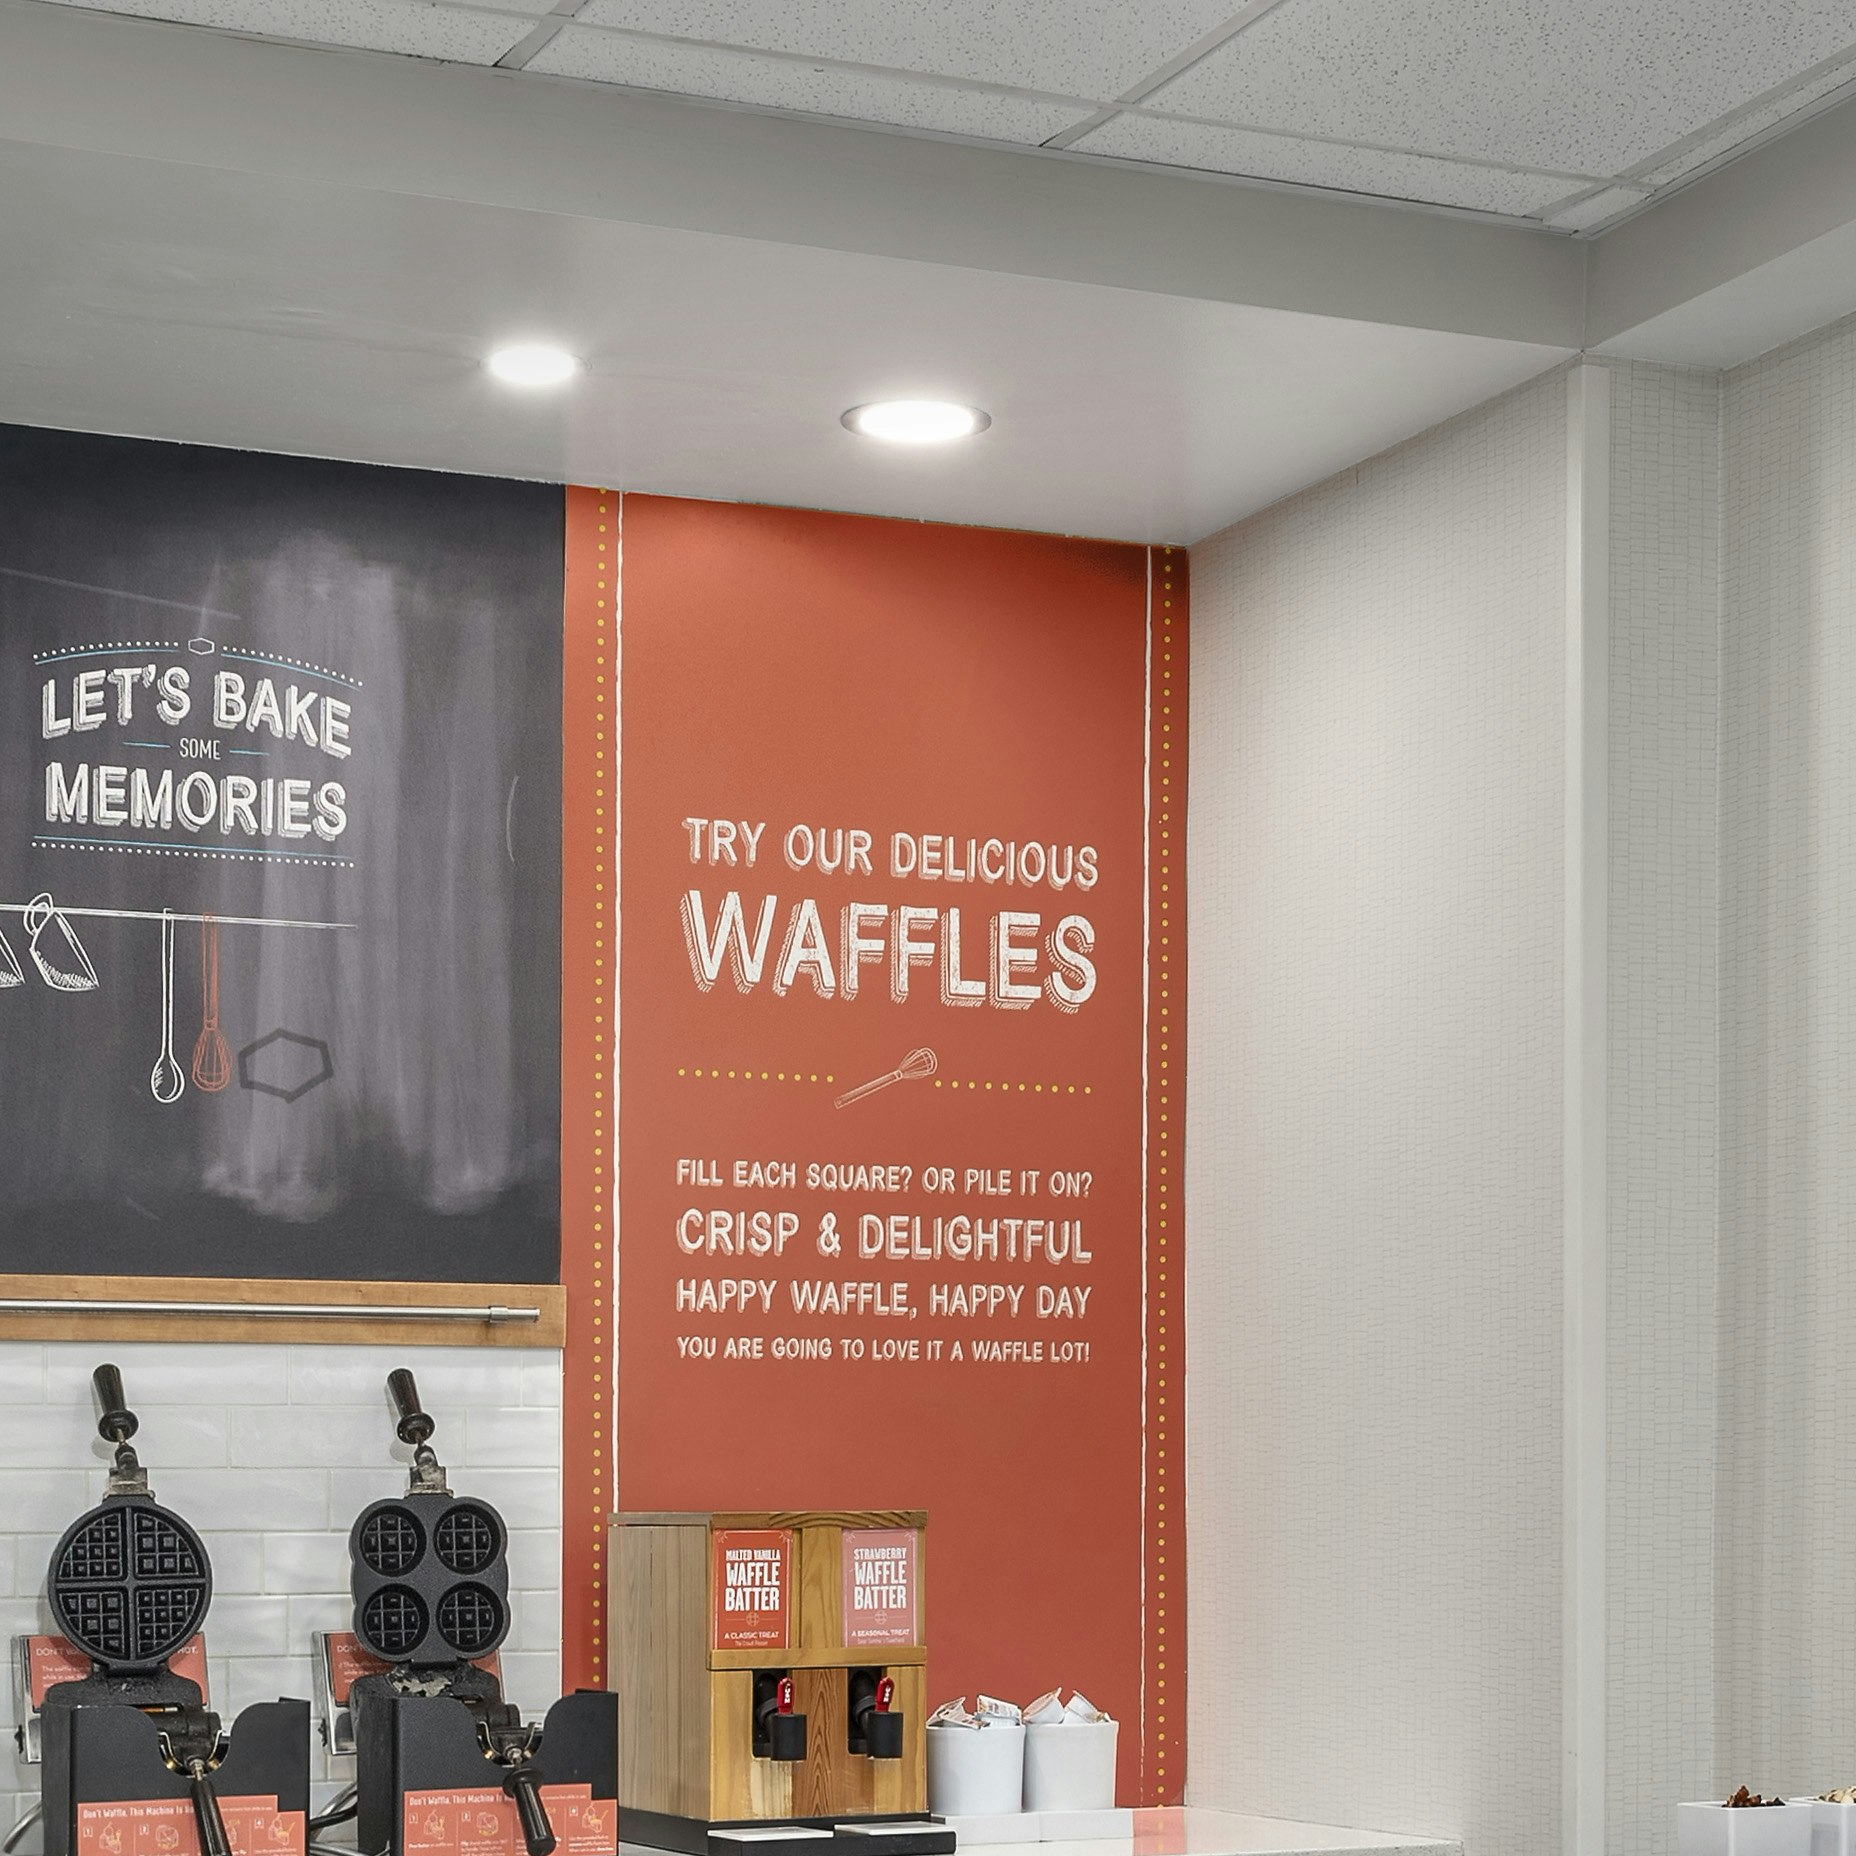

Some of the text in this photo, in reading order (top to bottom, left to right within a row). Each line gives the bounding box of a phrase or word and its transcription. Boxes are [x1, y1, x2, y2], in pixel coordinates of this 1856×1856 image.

[42, 664, 352, 759] LET'S BAKE
[179, 737, 221, 761] SOME
[45, 762, 348, 842] MEMORIES
[681, 817, 1099, 891] TRY OUR DELICIOUS
[680, 889, 1097, 1014] WAFFLES
[676, 1159, 1093, 1198] FILL EACH SQUARE? OR PILE IT ON?
[676, 1208, 1092, 1264] CRISP & DELIGHTFUL
[676, 1278, 1092, 1320] HAPPY WAFFLE, HAPPY DAY
[677, 1336, 1090, 1363] YOU ARE GOING TO LOVE IT A WAFFLE LOT!
[726, 1549, 781, 1561] MALTED VANILLA
[853, 1547, 907, 1560] STRAWBERRY
[726, 1562, 781, 1586] WAFFLE
[854, 1560, 907, 1585] WAFFLE
[725, 1587, 780, 1611] BATTER
[854, 1585, 907, 1610] BATTER
